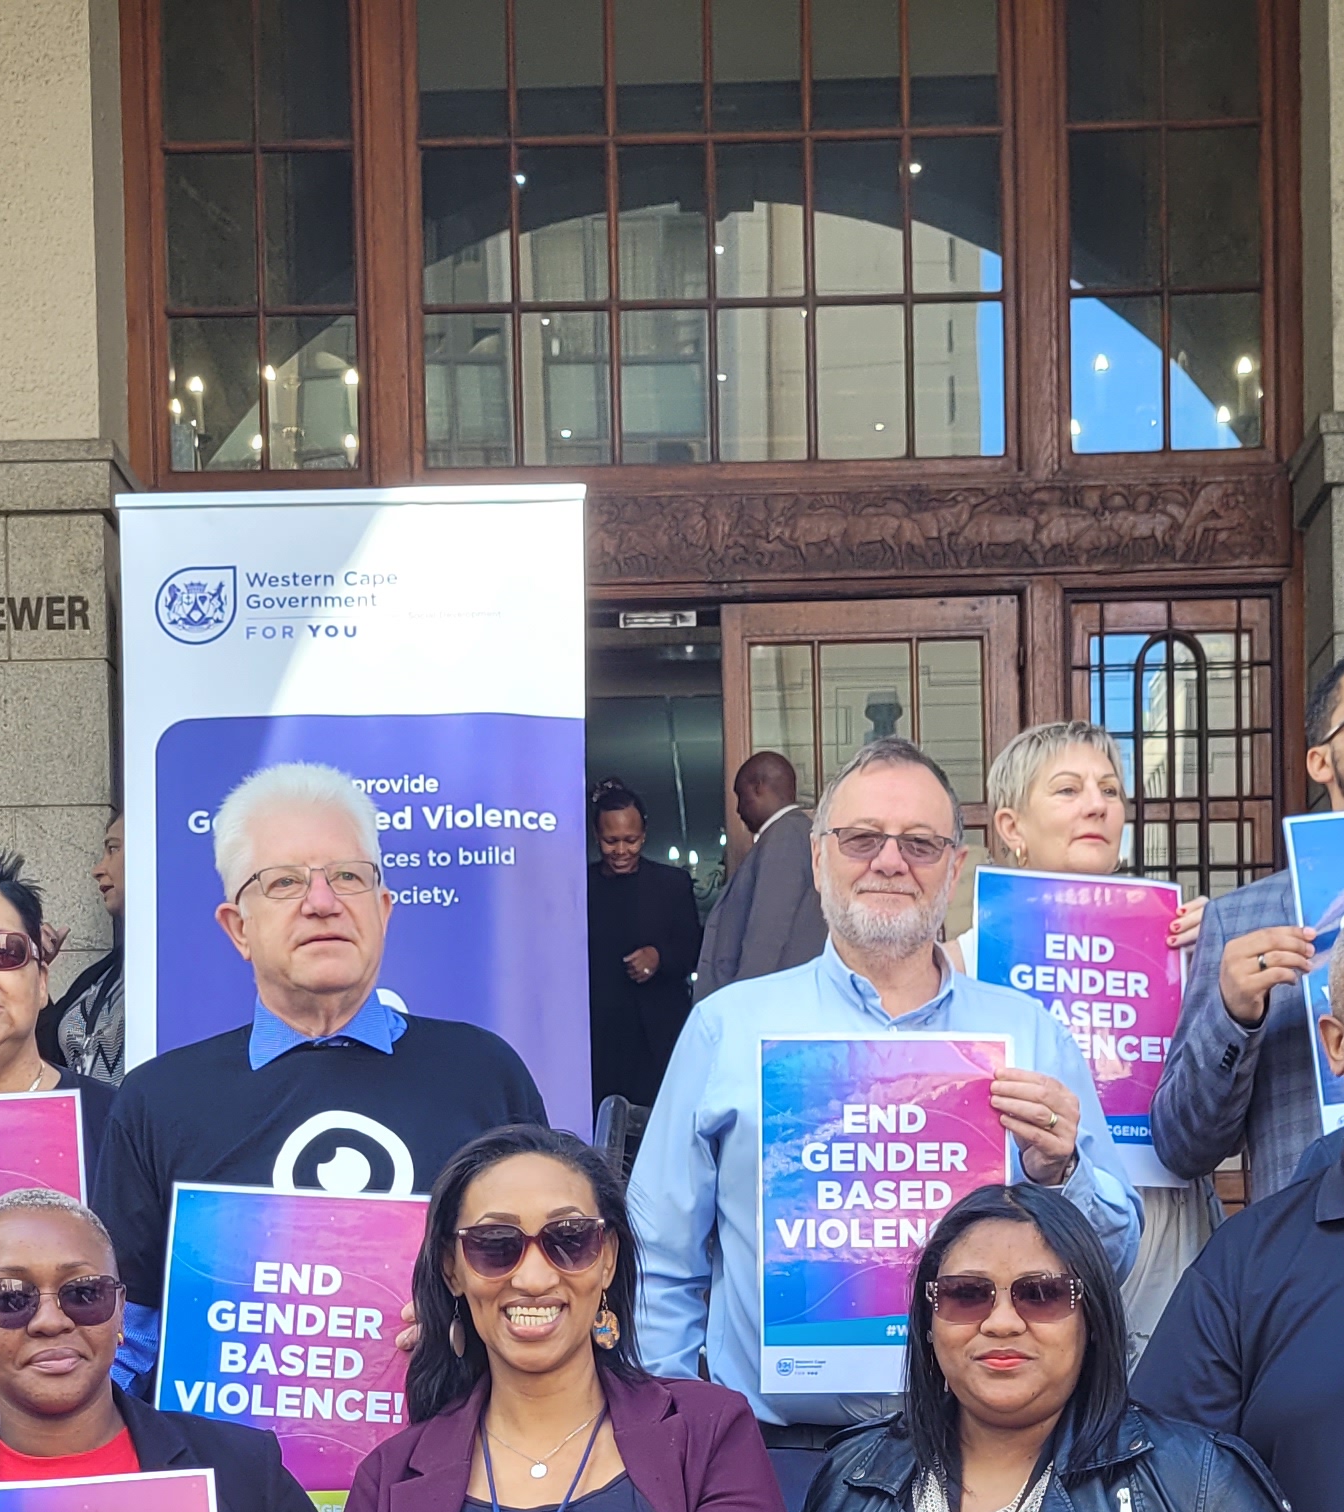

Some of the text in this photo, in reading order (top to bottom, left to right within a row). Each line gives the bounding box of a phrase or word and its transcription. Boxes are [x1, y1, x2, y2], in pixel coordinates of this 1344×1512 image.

[246, 571, 399, 589] Western Cape
[246, 592, 377, 610] Government
[246, 624, 358, 640] FOR YOU
[422, 804, 558, 832] Violence
[428, 848, 451, 867] to
[458, 847, 516, 866] build
[391, 886, 459, 906] ociety.
[1045, 933, 1115, 963] END
[1010, 964, 1149, 998] GENDER
[1049, 1000, 1137, 1029] ASED
[842, 1104, 927, 1134] END
[800, 1141, 968, 1173] GENDER
[816, 1180, 953, 1210] BASED
[775, 1218, 940, 1248] VIOLEN
[253, 1261, 342, 1296] END
[206, 1301, 383, 1341] GENDER
[219, 1342, 364, 1379] BASED
[174, 1380, 403, 1424] VIOLENCE!
